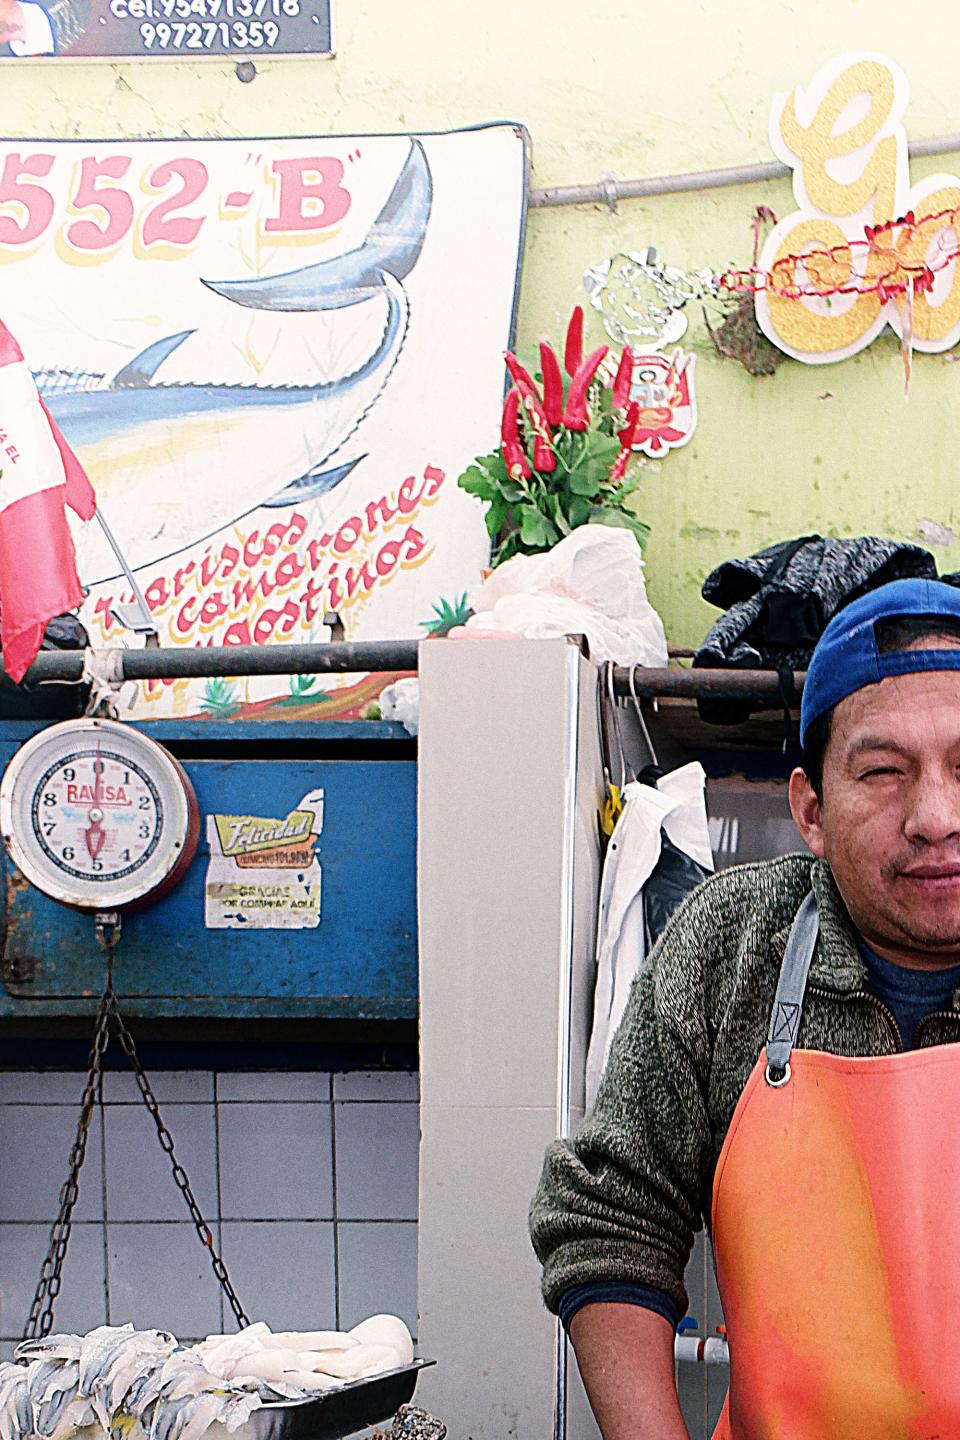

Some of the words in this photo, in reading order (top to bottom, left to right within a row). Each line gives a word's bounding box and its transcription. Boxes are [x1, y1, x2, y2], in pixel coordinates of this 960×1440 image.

[140, 22, 279, 48] 997271359
[176, 464, 446, 633] camarones
[63, 768, 76, 782] 9
[93, 761, 105, 775] 0
[123, 771, 132, 785] 1
[43, 793, 57, 807] 8
[138, 796, 150, 810] 2
[43, 822, 57, 836] 7
[138, 825, 150, 839] 3
[224, 815, 309, 852] Felicidad
[62, 847, 75, 861] 6
[119, 849, 132, 862] 4
[92, 857, 104, 871] 5
[239, 886, 290, 898] GRACIAS
